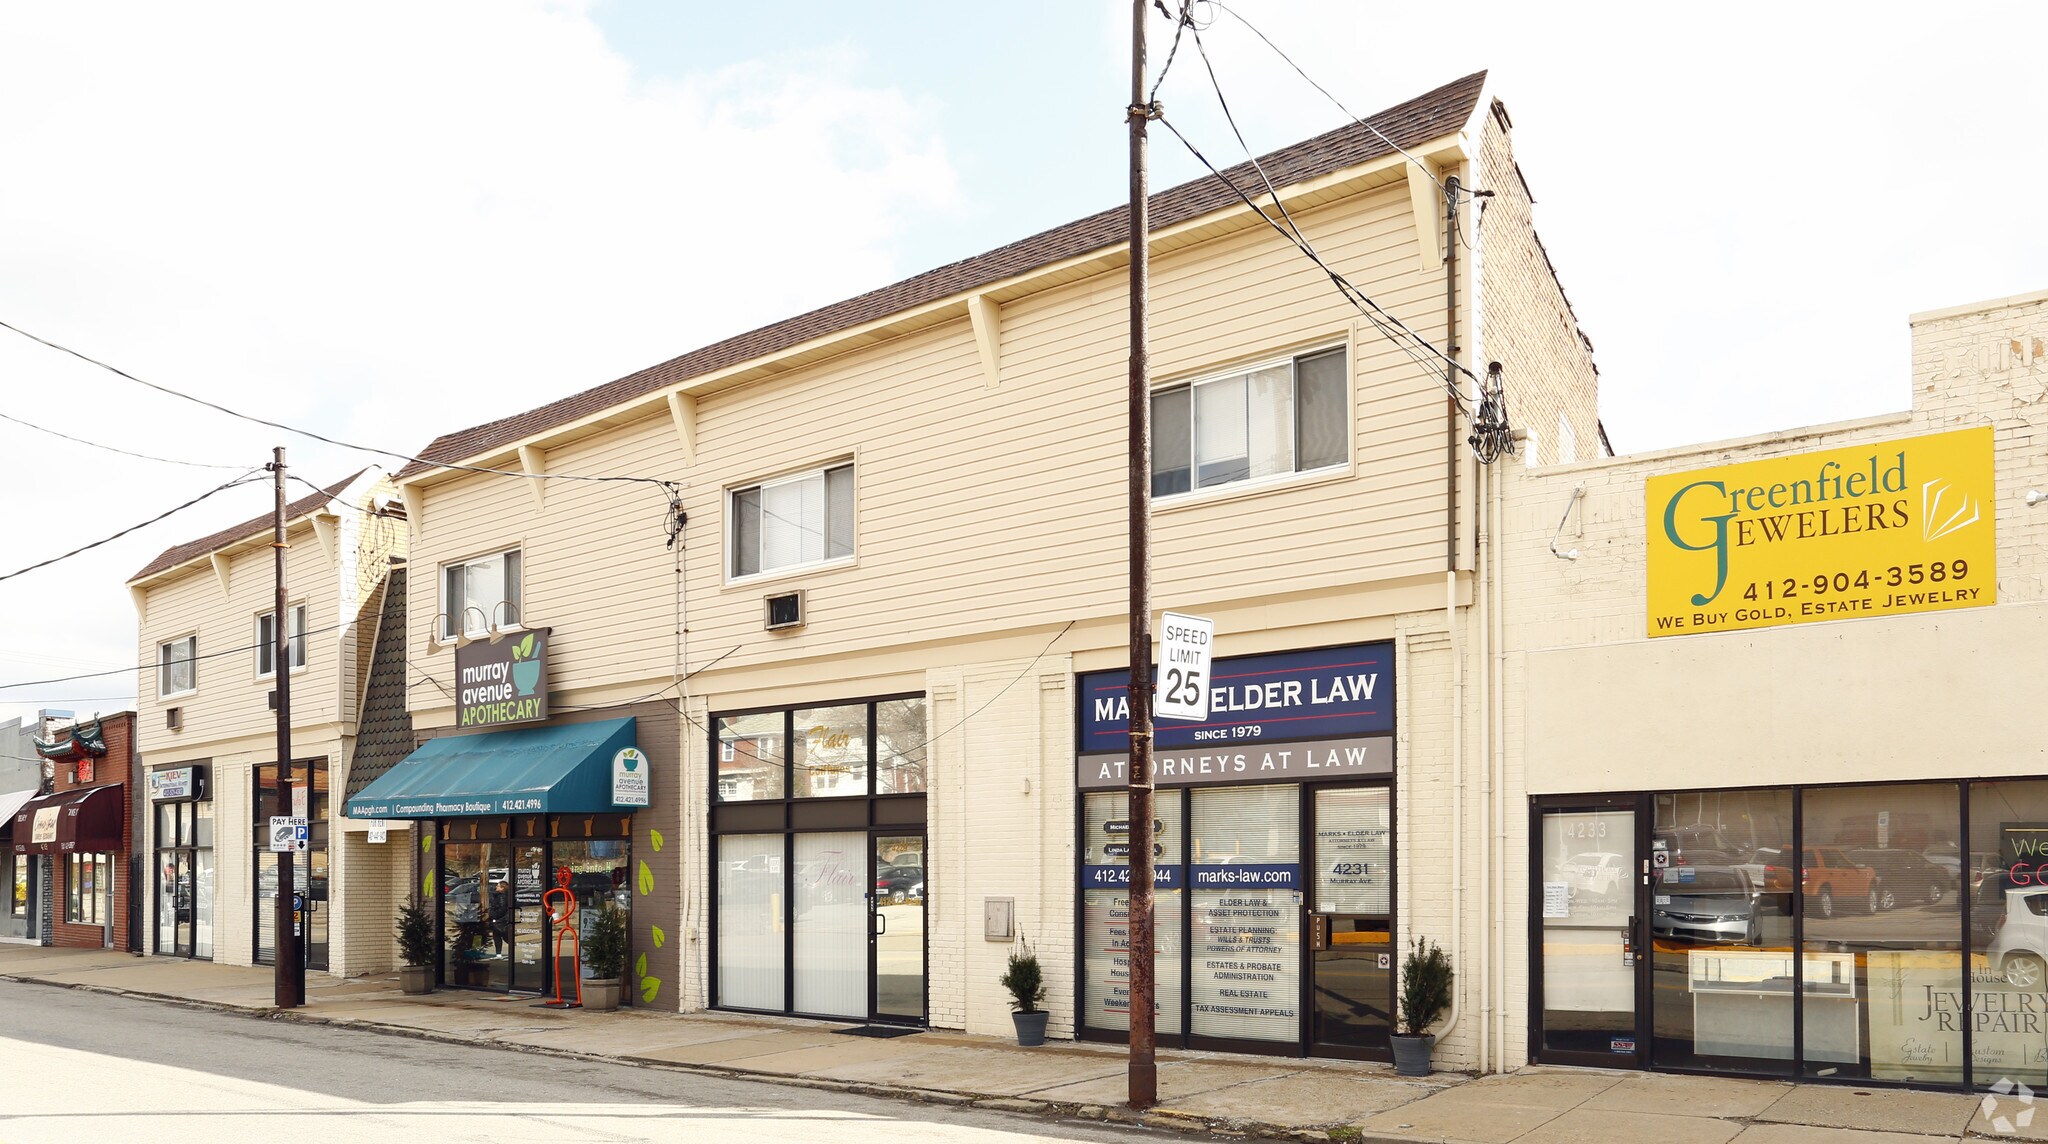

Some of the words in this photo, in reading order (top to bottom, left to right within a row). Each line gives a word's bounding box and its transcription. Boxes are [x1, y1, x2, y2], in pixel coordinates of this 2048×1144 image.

[1663, 451, 1908, 551] Greenfield
[1743, 559, 1969, 602] 412-904-3589
[1801, 598, 1873, 616] ESTATE
[1882, 587, 1981, 609] JEWELRY
[1166, 626, 1208, 645] SPEED
[1169, 647, 1202, 665] LIMIT
[463, 661, 510, 684] murray
[462, 683, 513, 705] avenue
[1165, 668, 1201, 706] 25
[1211, 680, 1302, 714] ELDER
[1310, 673, 1378, 704] LAW
[461, 698, 542, 726] APOTHECARY
[1194, 729, 1228, 741] SINCE
[1231, 725, 1262, 739] 1979
[1099, 754, 1247, 779] ATRNEYS
[1260, 751, 1292, 771] AT
[1307, 747, 1367, 768] LAW
[396, 804, 434, 814] Compounding
[436, 802, 464, 813] Pharmacy
[465, 801, 492, 812] Boutique
[502, 799, 542, 811] 412.421.4996
[297, 827, 306, 839] P
[1568, 821, 1607, 838] 4233
[1198, 868, 1291, 883] marks-law.com
[1333, 863, 1368, 875] 4231
[1219, 899, 1243, 907] ELDER
[1244, 899, 1262, 907] LAW
[1109, 928, 1126, 936] Fees
[1112, 939, 1118, 947] In
[1245, 936, 1271, 944] TRUSTS
[1206, 961, 1238, 969] ESTATES
[1239, 962, 1245, 970] &
[1246, 963, 1282, 971] PROBATE
[1978, 963, 1992, 974] In
[1213, 972, 1274, 981] ADMINISTRATION
[1219, 989, 1238, 997] REAL
[1240, 990, 1268, 998] ESTATE
[1210, 1005, 1258, 1015] ASSESSMENT
[1259, 1008, 1294, 1017] APPEALS
